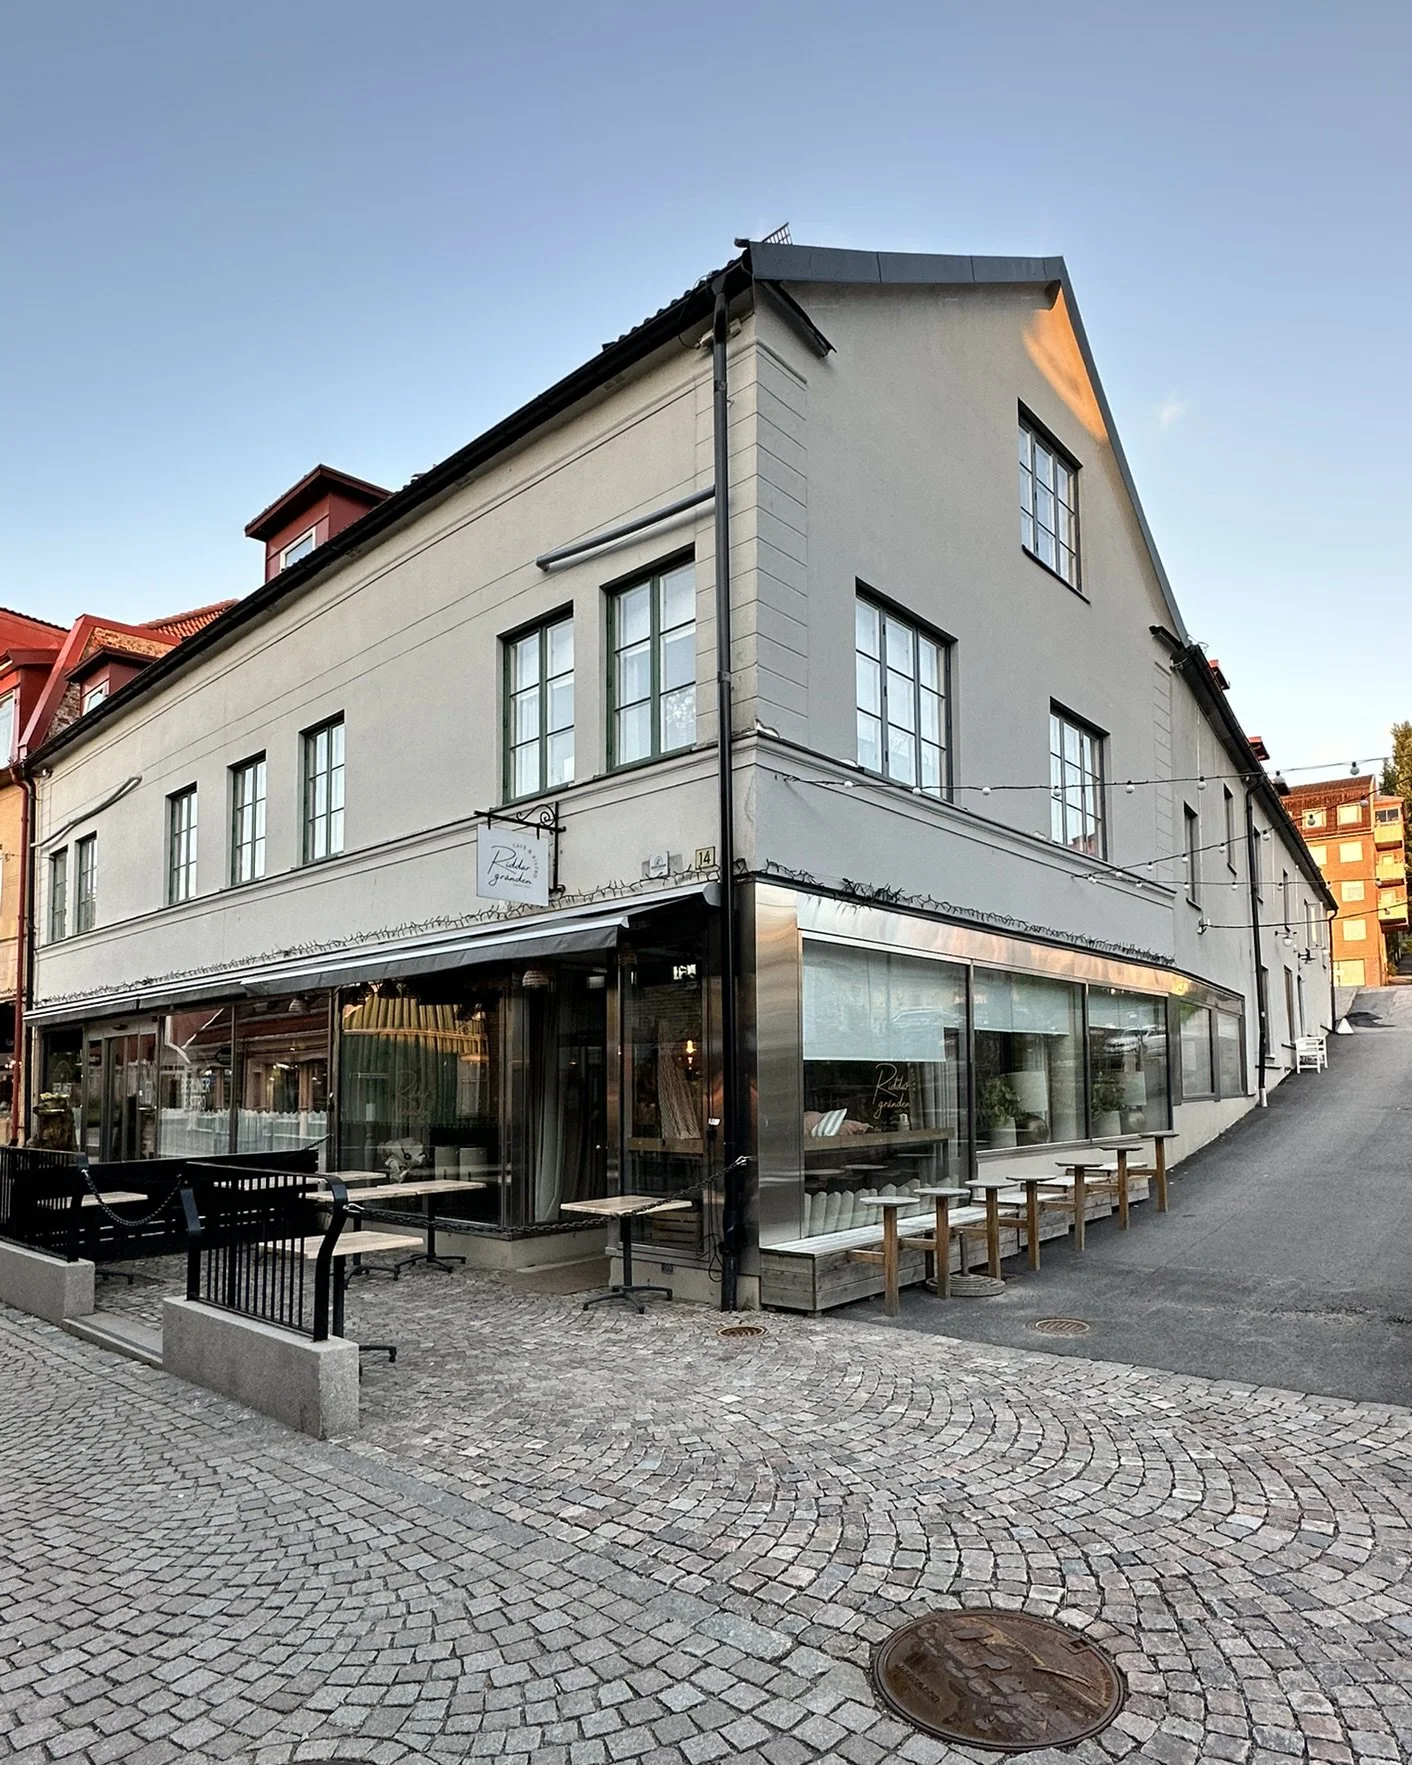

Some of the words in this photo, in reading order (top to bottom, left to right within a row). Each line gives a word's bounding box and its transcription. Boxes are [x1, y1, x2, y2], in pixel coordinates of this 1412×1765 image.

[487, 844, 530, 874] Ridder
[698, 850, 711, 865] 14
[872, 1062, 911, 1105] Ridder
